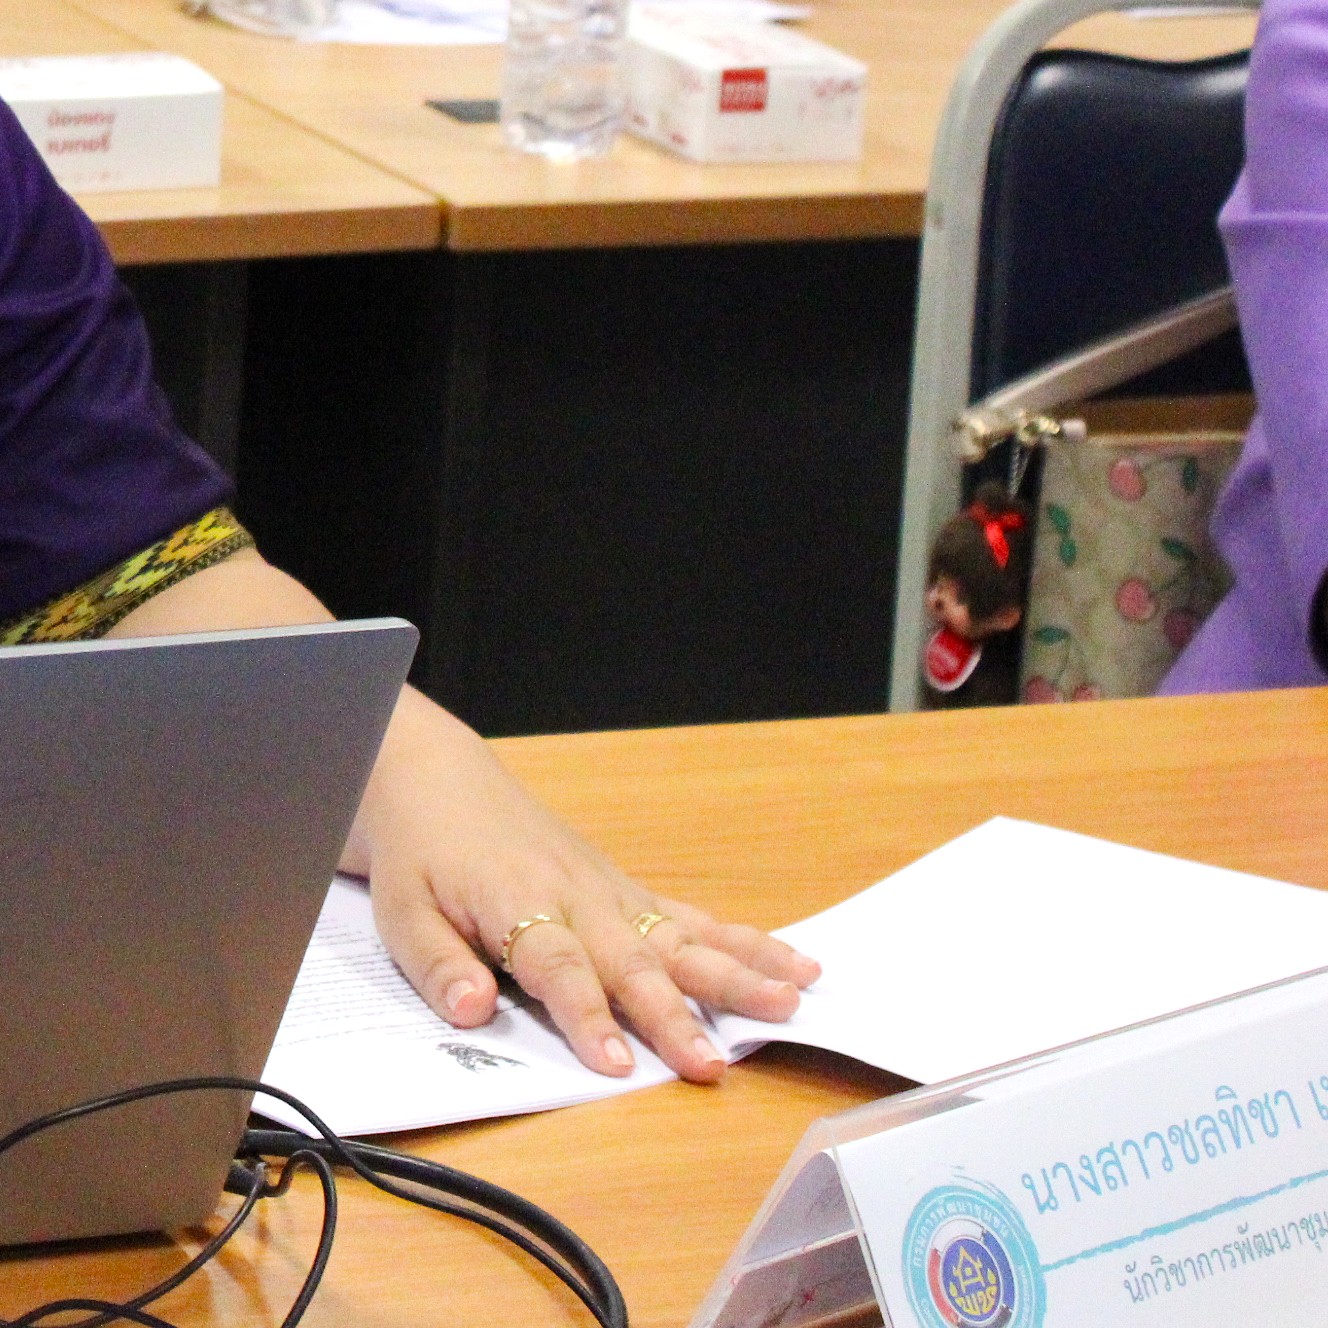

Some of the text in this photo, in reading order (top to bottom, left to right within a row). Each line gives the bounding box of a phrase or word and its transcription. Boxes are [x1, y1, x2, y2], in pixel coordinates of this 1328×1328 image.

[1021, 1084, 1303, 1215] นางสาวชลทิชา
